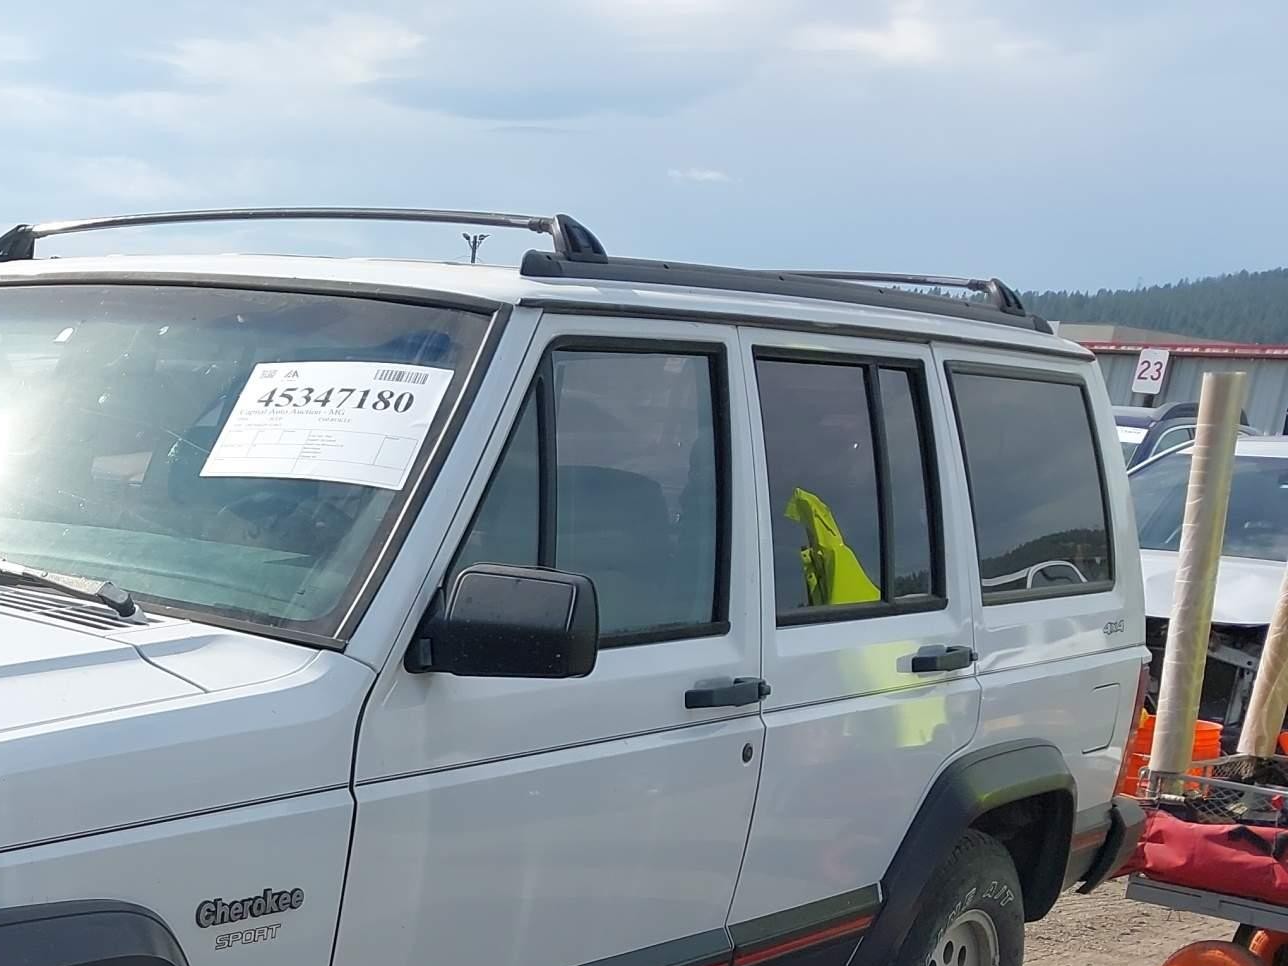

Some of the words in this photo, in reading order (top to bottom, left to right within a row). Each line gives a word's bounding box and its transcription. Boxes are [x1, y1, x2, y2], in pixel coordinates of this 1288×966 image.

[1137, 360, 1162, 381] 23
[257, 387, 415, 413] 45347180
[196, 887, 305, 928] Cherokee
[215, 924, 281, 950] SPORT
